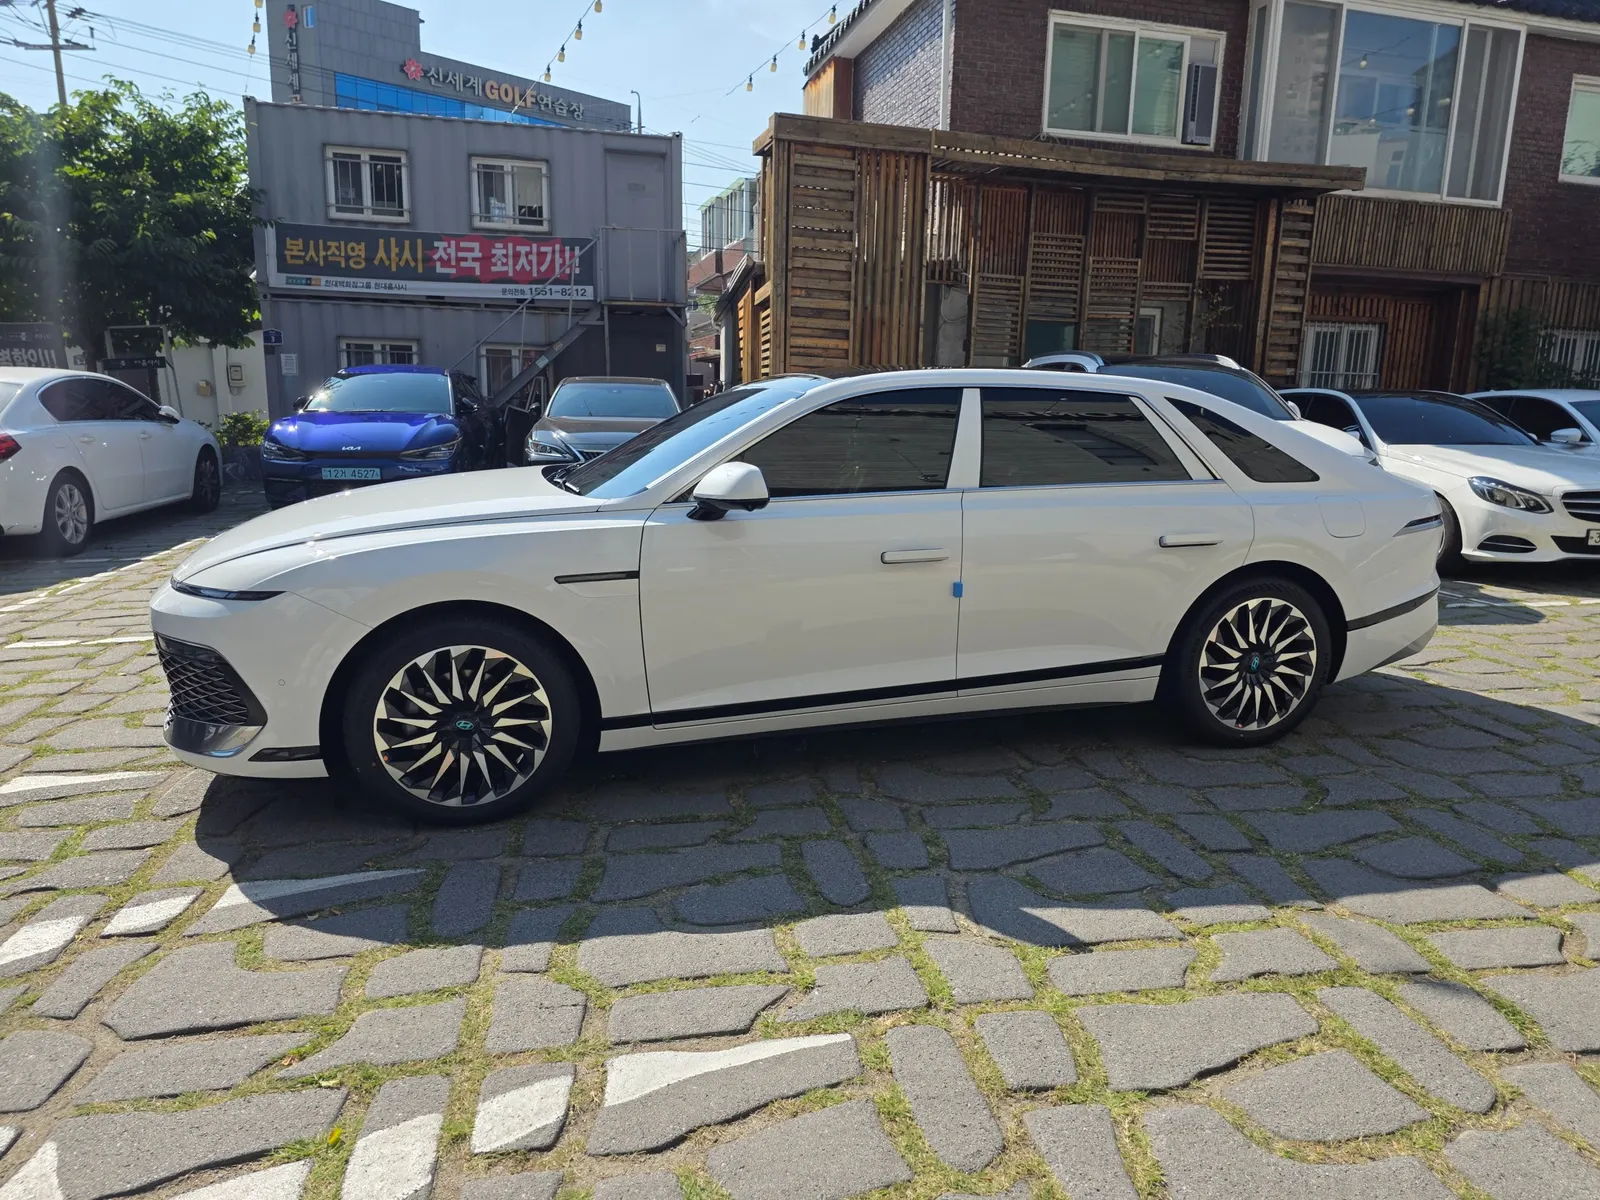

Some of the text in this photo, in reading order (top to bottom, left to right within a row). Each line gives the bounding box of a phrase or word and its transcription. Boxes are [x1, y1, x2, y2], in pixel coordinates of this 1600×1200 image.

[284, 237, 580, 277] 본사직영 샤시 전국 최저가!!
[351, 469, 376, 479] 4527
